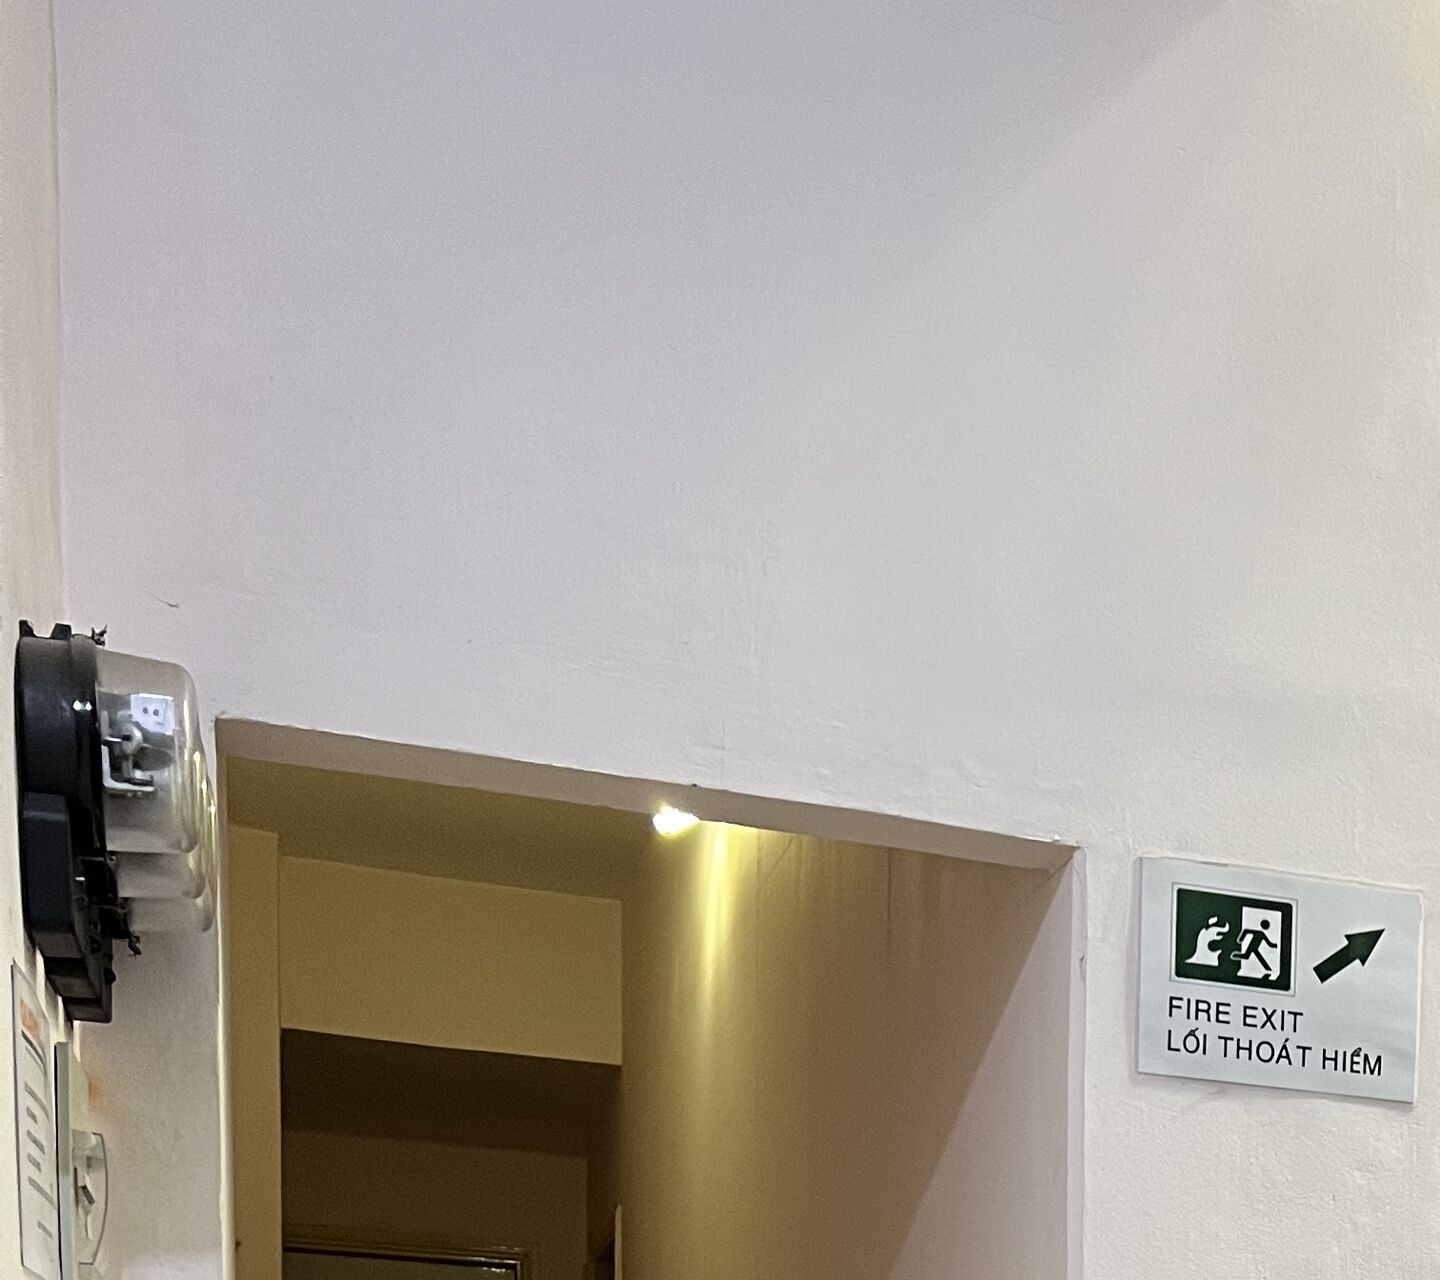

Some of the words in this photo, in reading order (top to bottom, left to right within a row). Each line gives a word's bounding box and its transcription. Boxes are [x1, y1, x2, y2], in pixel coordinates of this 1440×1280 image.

[1168, 996, 1231, 1025] FIRE
[1242, 1005, 1304, 1033] EXIT
[1167, 1027, 1207, 1056] LỐI
[1217, 1035, 1312, 1067] THOÁT
